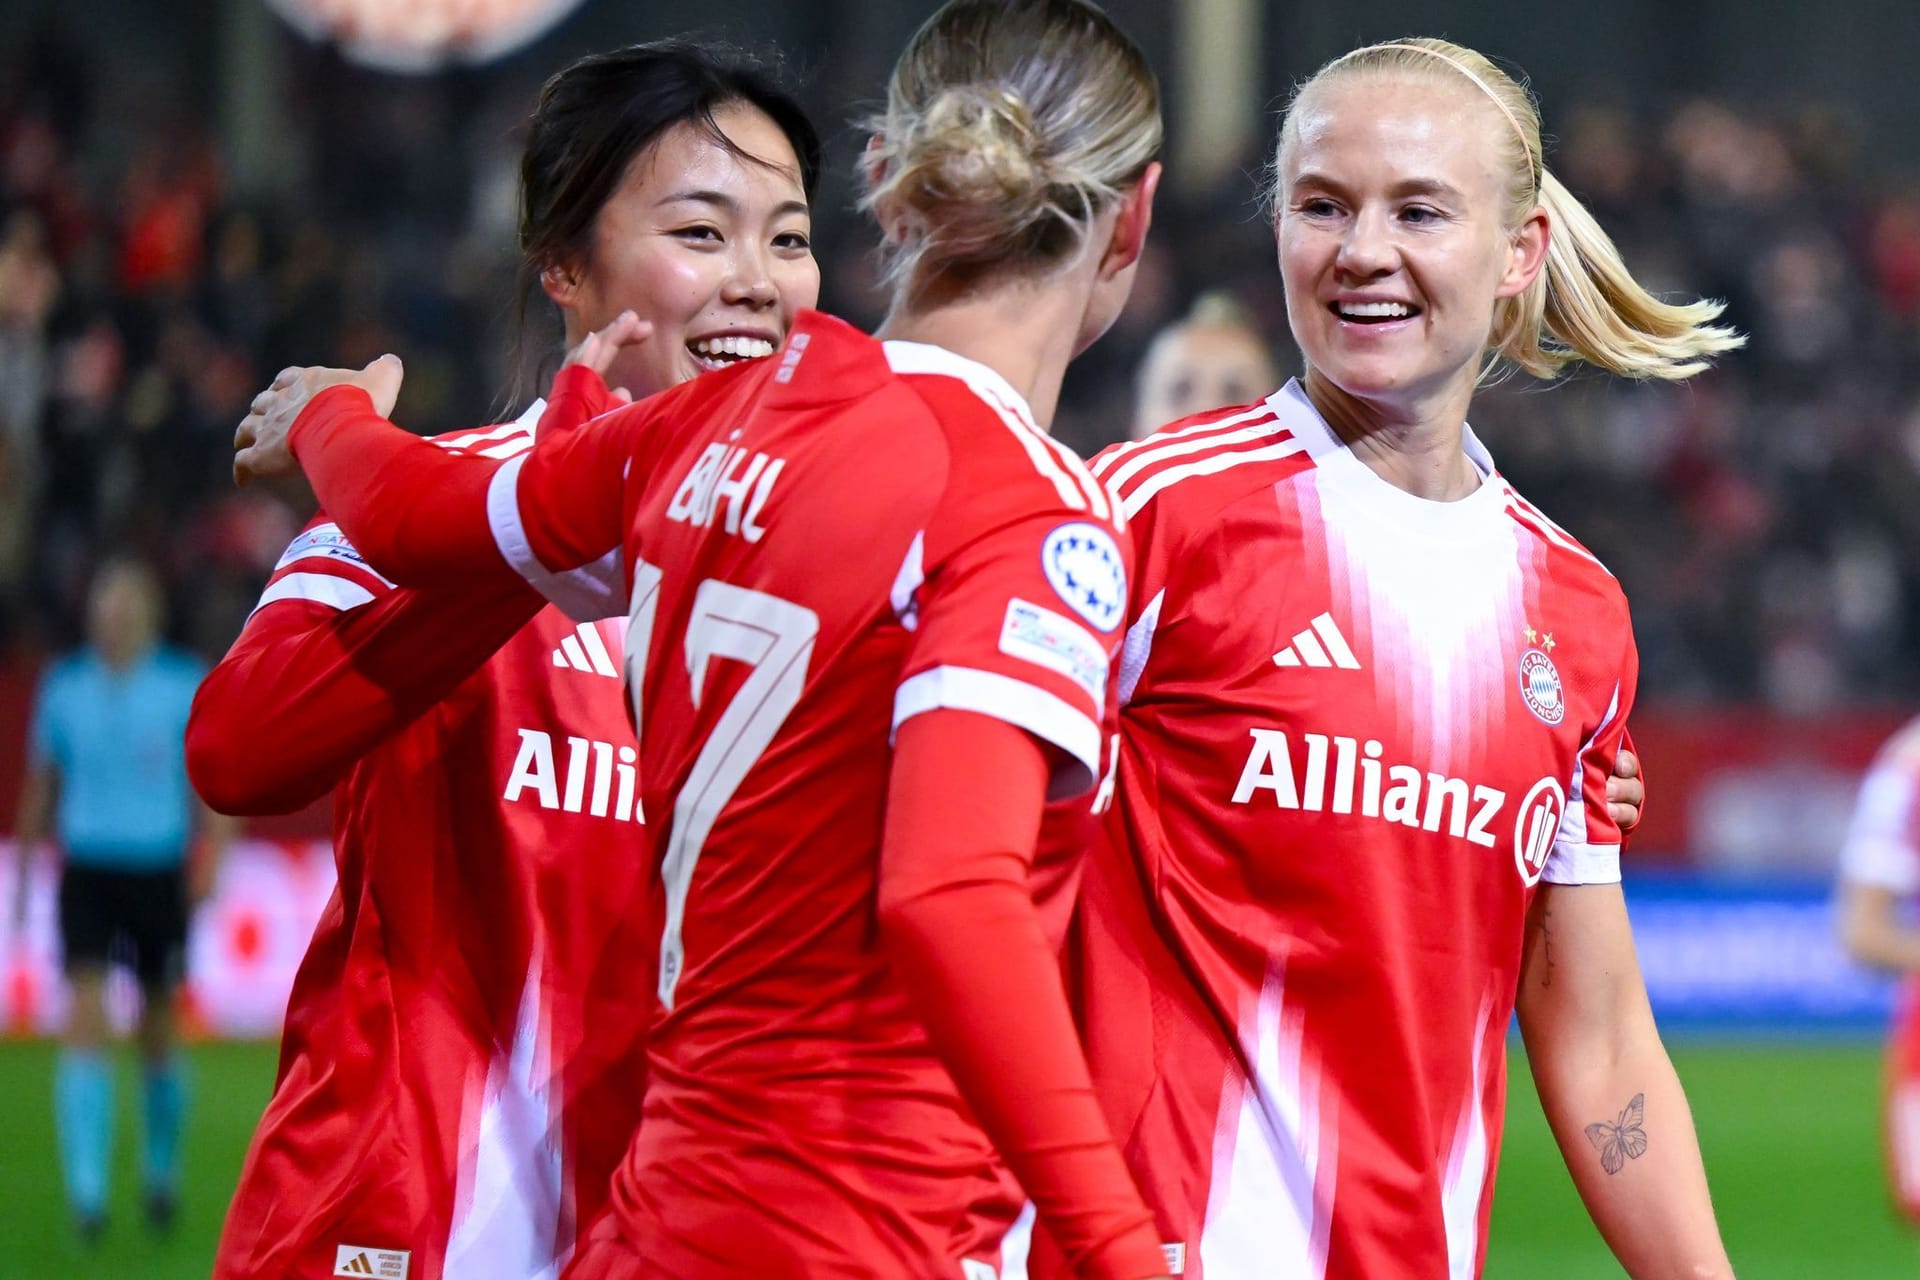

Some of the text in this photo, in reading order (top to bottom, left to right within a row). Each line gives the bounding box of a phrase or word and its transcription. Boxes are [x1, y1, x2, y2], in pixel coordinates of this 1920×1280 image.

[1522, 659, 1533, 676] FC
[503, 728, 645, 825] Alli
[1231, 728, 1506, 848] Allianz
